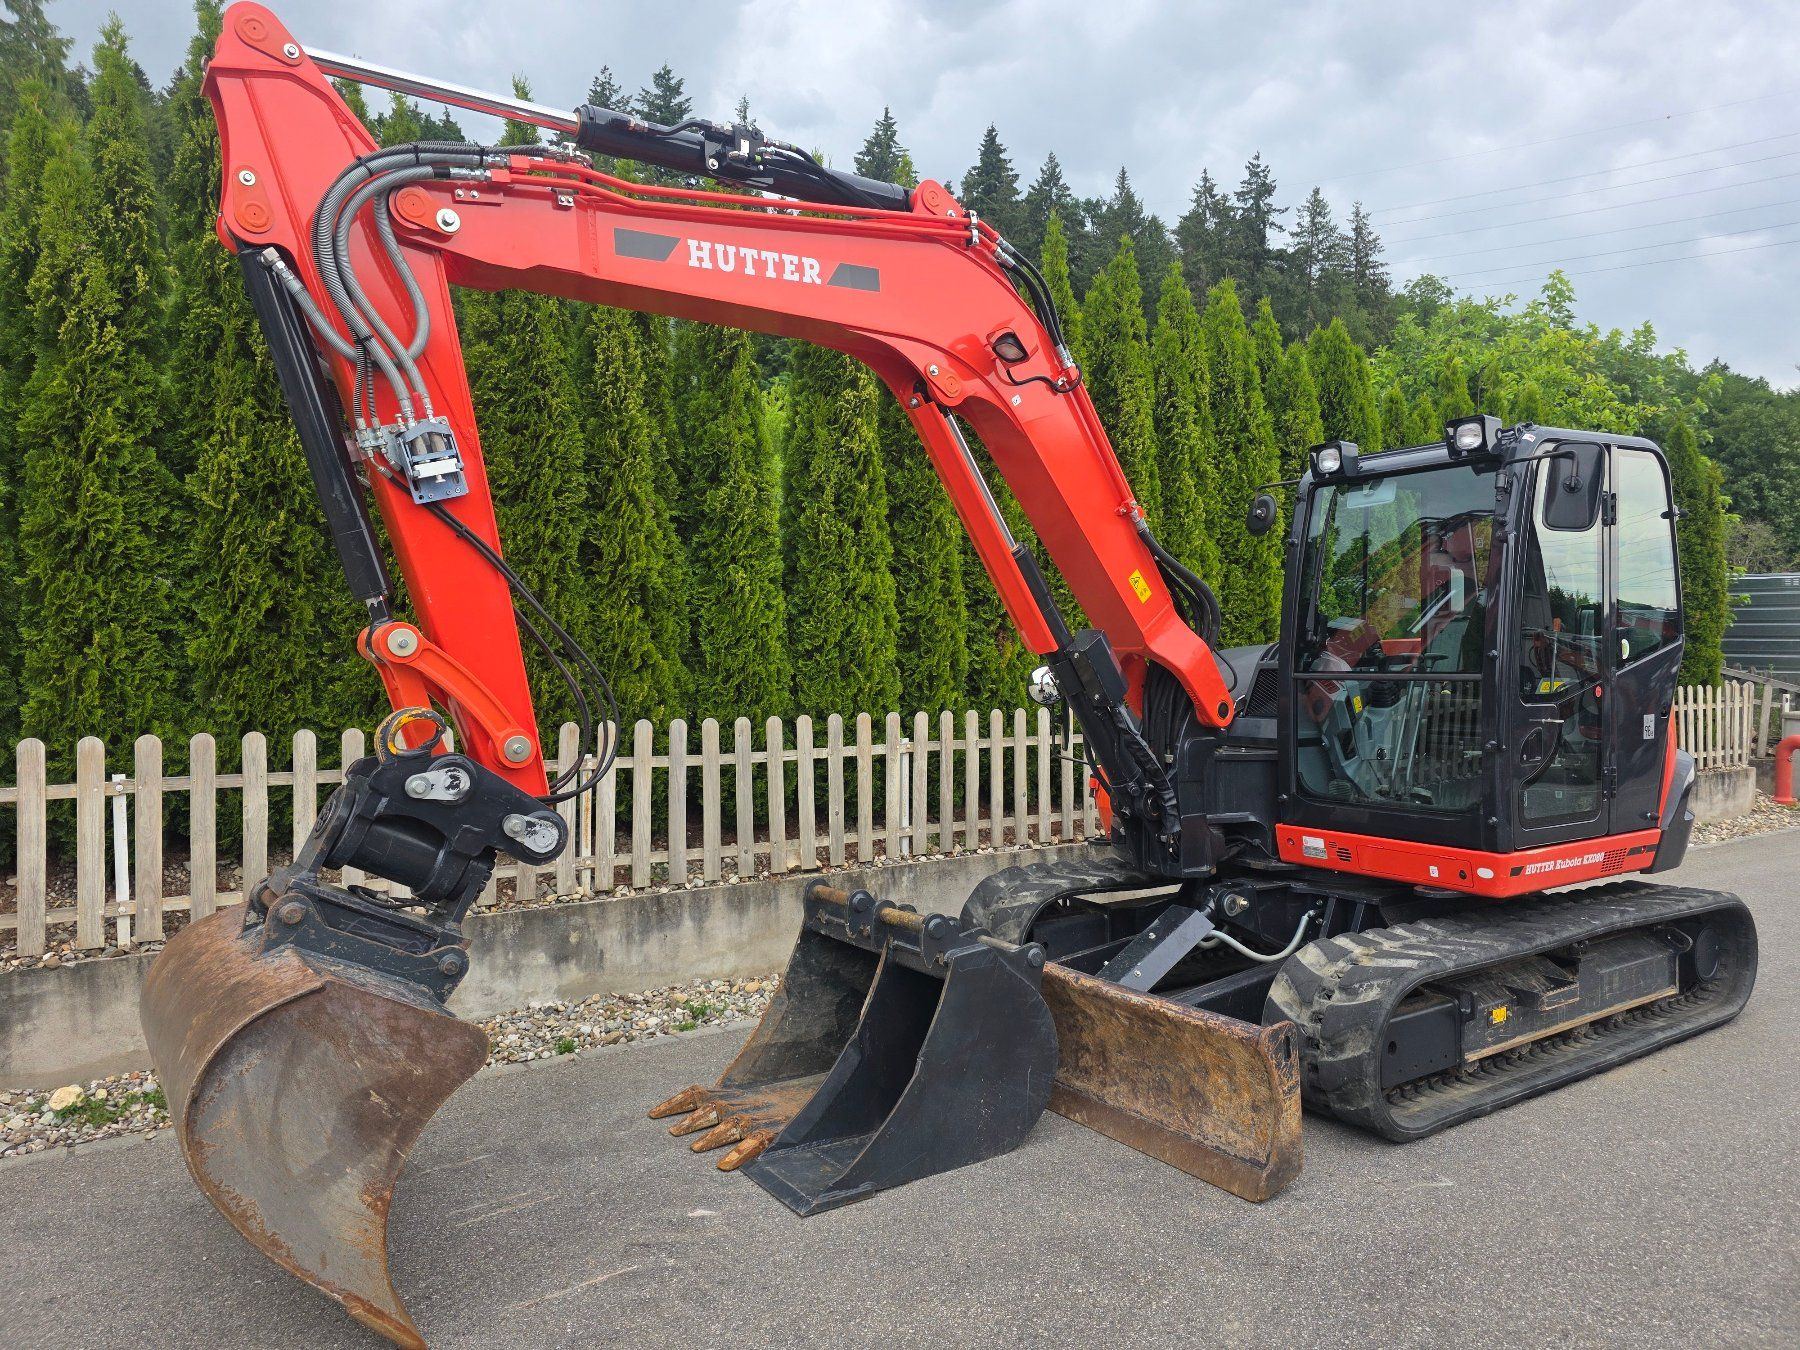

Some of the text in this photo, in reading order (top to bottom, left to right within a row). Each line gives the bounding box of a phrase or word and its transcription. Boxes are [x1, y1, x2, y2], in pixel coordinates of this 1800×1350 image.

[687, 238, 822, 285] HUTTER
[1525, 860, 1555, 875] HUTTER
[1555, 857, 1583, 870] Kubota
